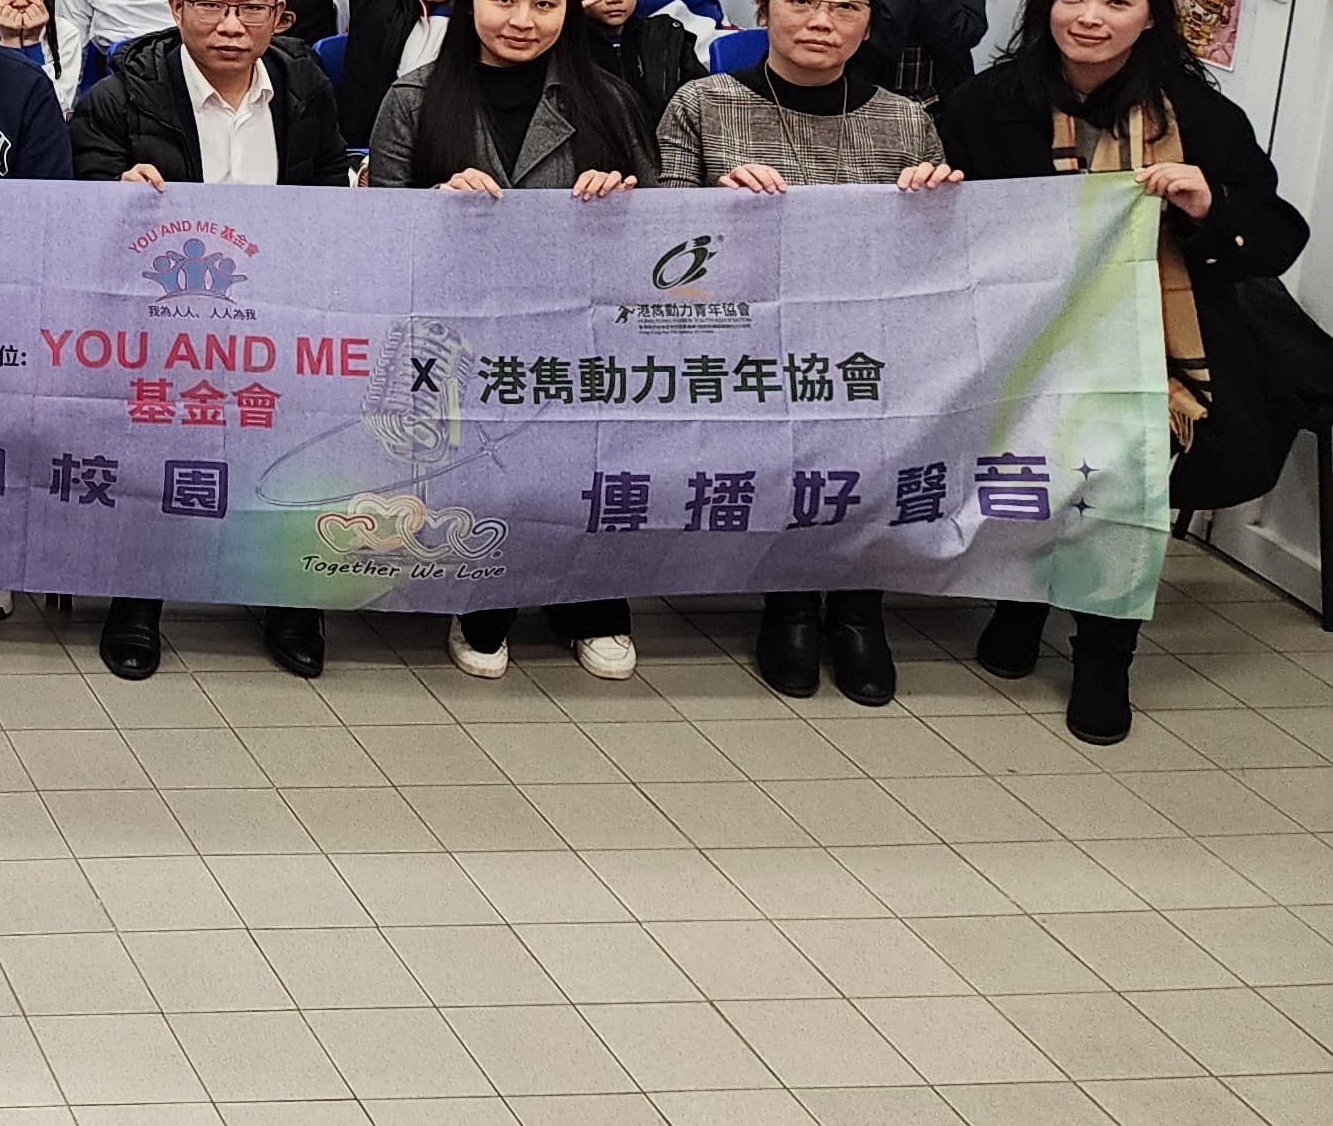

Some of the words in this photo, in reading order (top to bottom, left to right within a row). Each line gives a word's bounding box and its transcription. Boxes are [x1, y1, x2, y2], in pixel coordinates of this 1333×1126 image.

[128, 230, 157, 254] YOU
[160, 220, 192, 237] AND
[196, 220, 218, 234] ME
[220, 225, 260, 258] 基金會
[40, 329, 151, 370] YOU
[165, 332, 277, 373] AND
[296, 337, 370, 377] ME
[410, 358, 440, 393] X
[128, 379, 281, 429] 基金會
[582, 452, 1052, 533] 傳播好聲音
[301, 556, 402, 580] Together
[409, 563, 450, 580] We
[456, 562, 506, 579] Love
